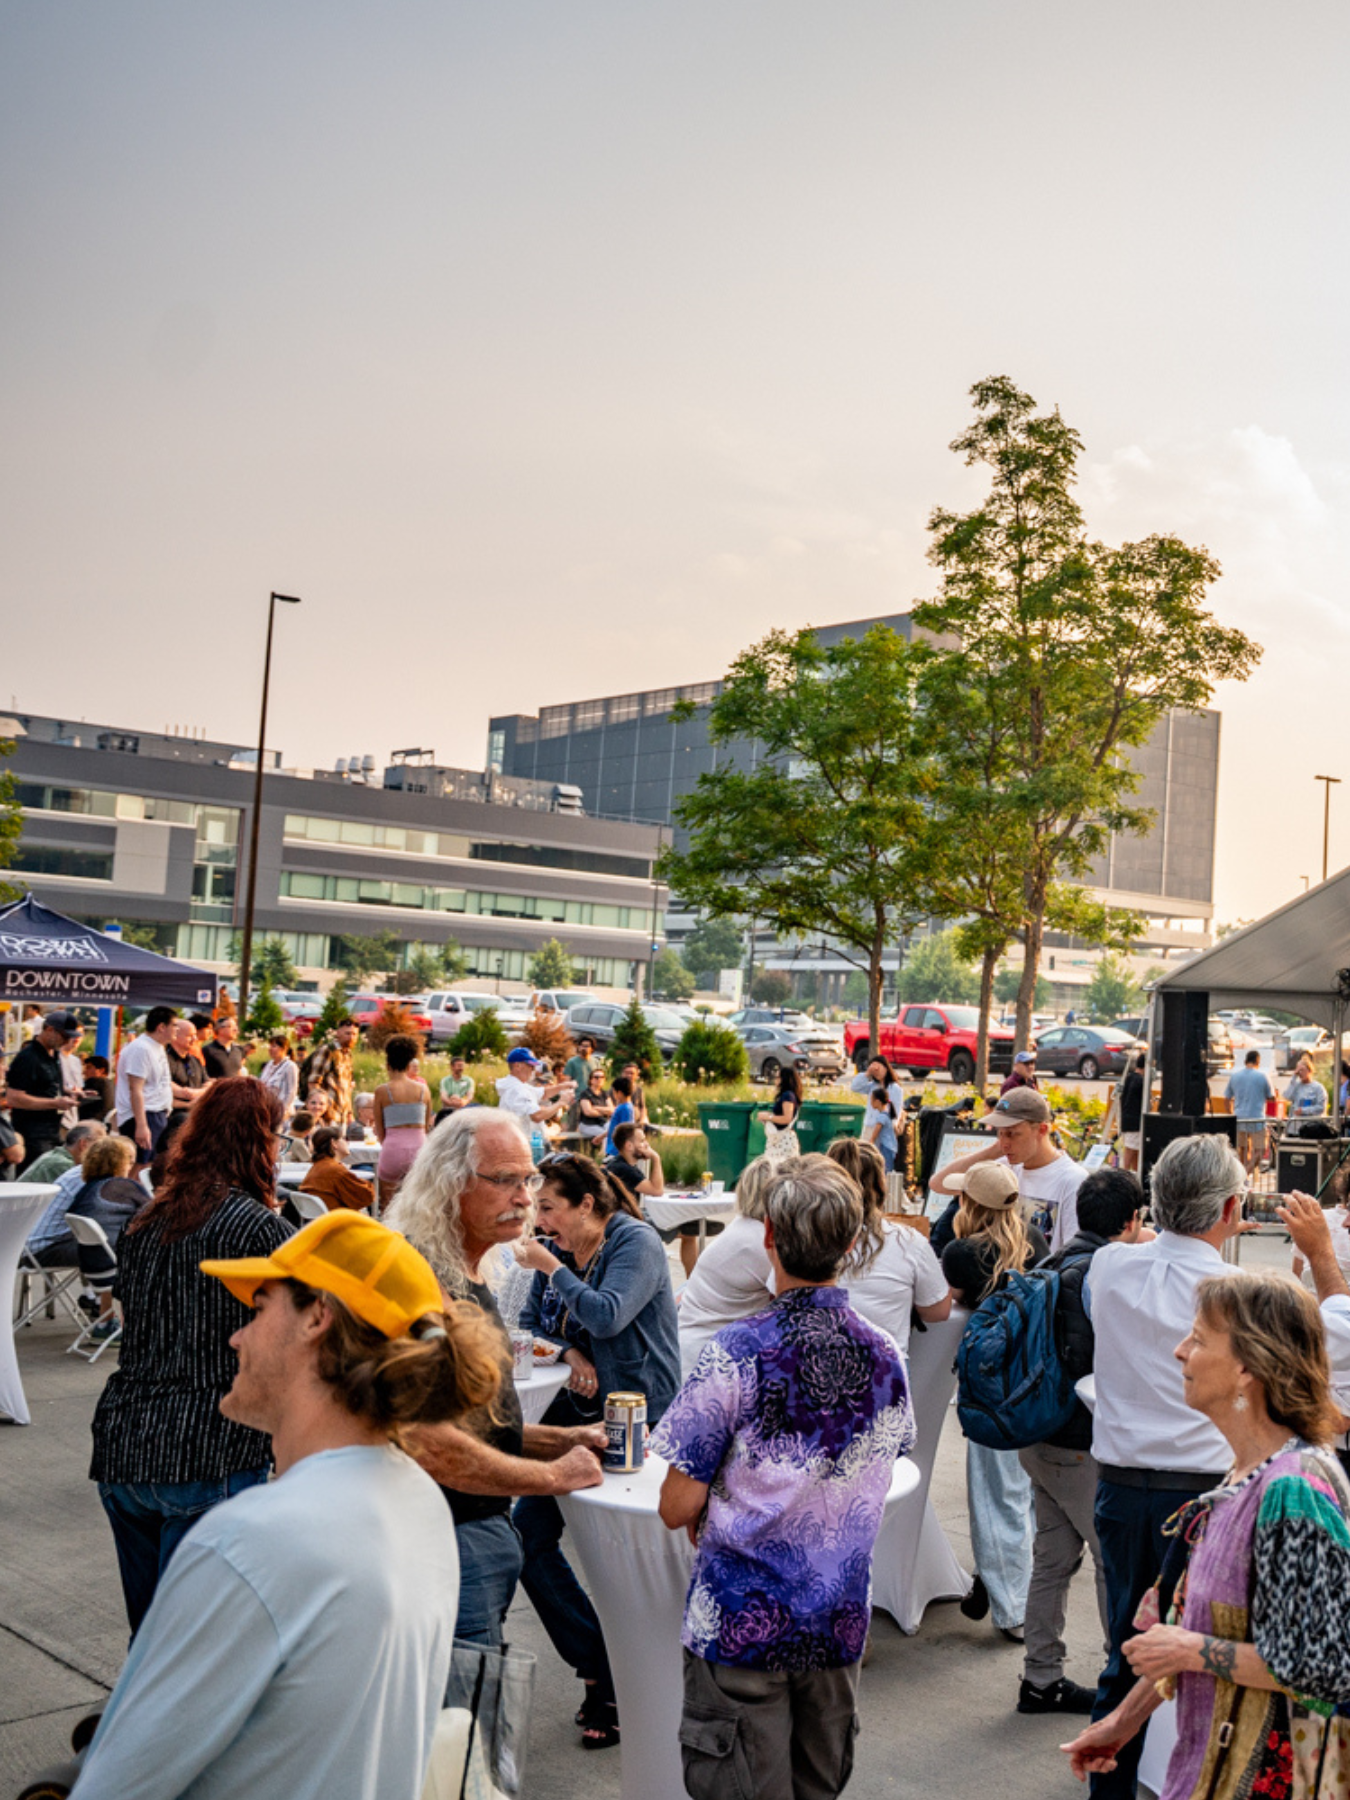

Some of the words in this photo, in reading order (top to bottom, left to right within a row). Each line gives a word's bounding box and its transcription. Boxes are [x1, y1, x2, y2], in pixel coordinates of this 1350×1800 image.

[6, 970, 130, 992] DOWNTOWN
[5, 988, 65, 998] Rochester,
[71, 991, 128, 1001] Minnesota
